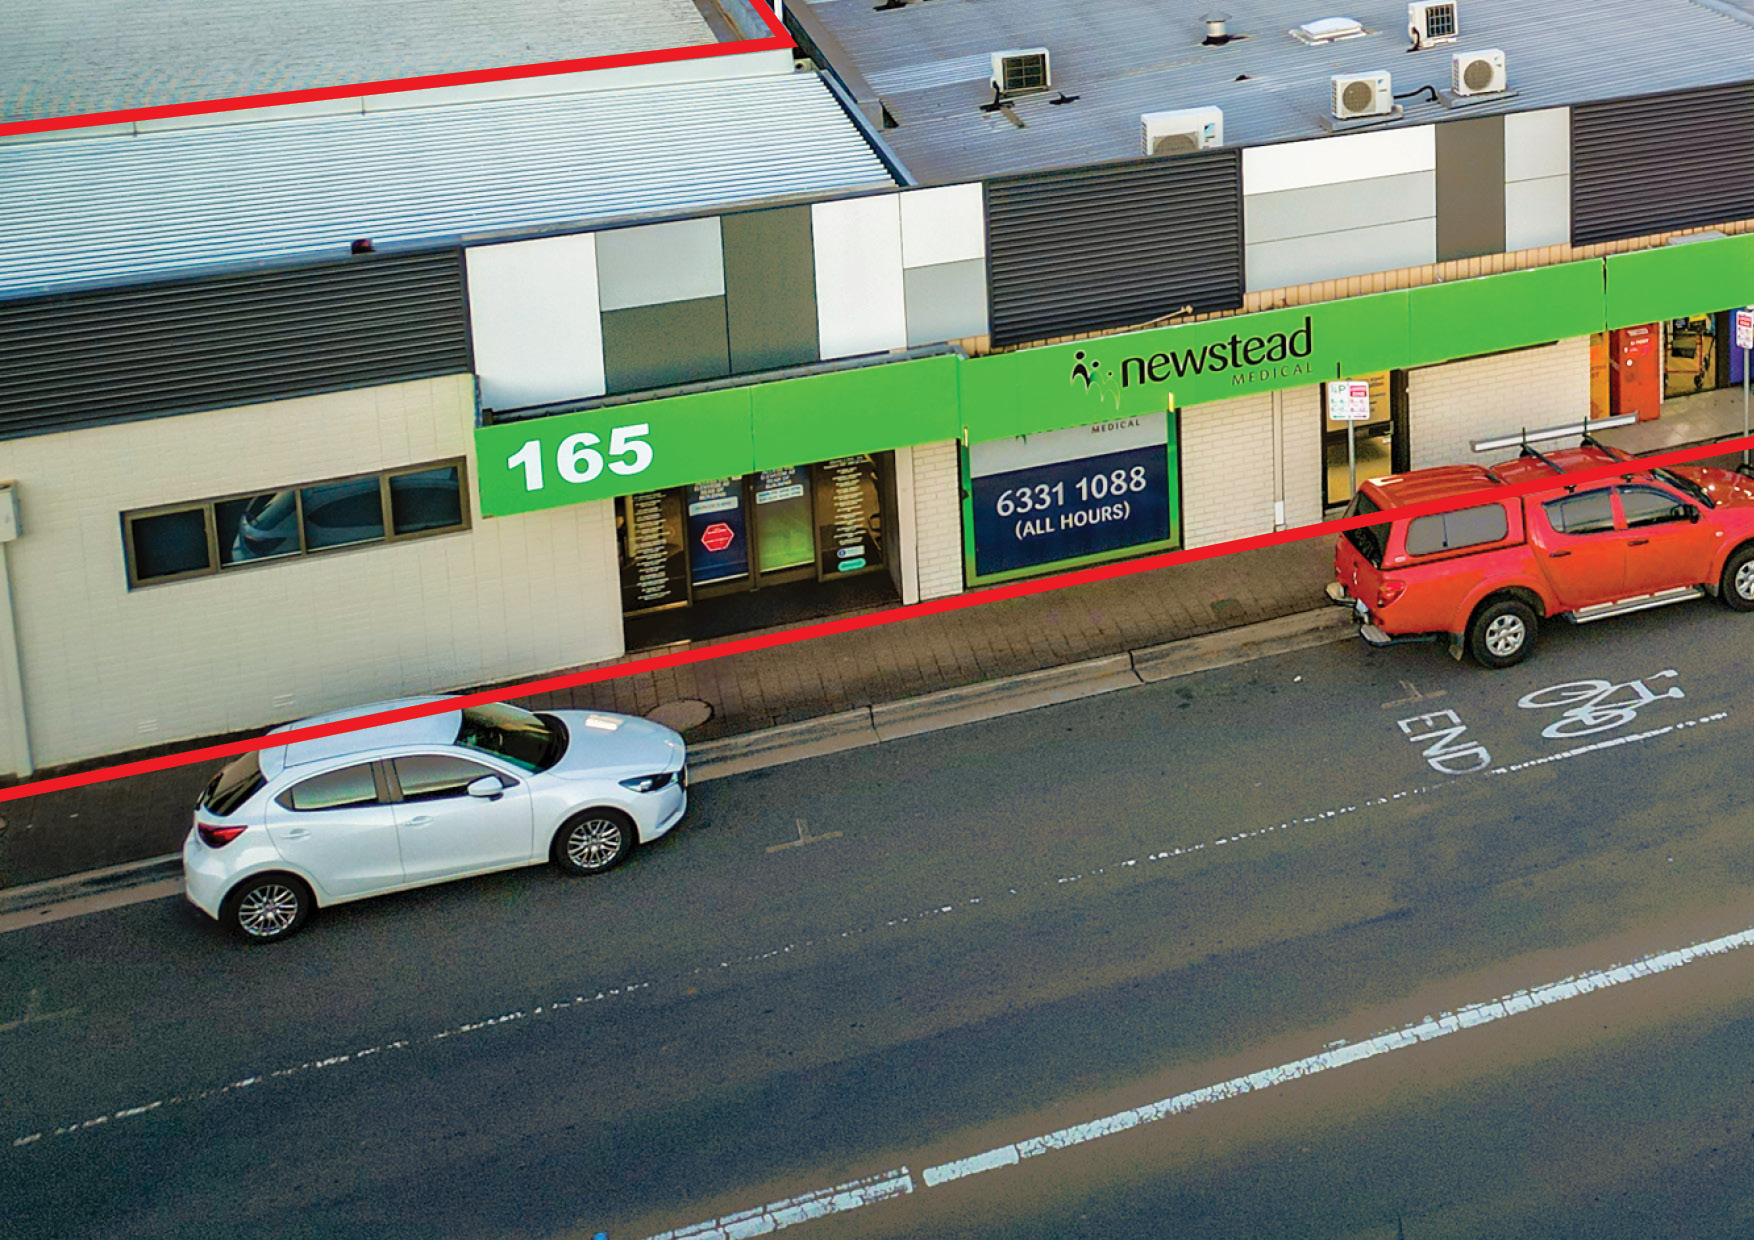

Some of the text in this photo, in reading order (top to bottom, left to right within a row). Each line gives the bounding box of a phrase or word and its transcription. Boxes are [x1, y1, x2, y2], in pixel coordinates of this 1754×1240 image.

[1121, 316, 1312, 388] newstead
[1232, 362, 1313, 386] MEDICAL
[1091, 418, 1141, 434] MEDICAL
[507, 423, 654, 491] 165
[996, 465, 1147, 517] 6331 1088
[1015, 500, 1131, 540] (ALL HOURS)
[1397, 709, 1491, 775] END
